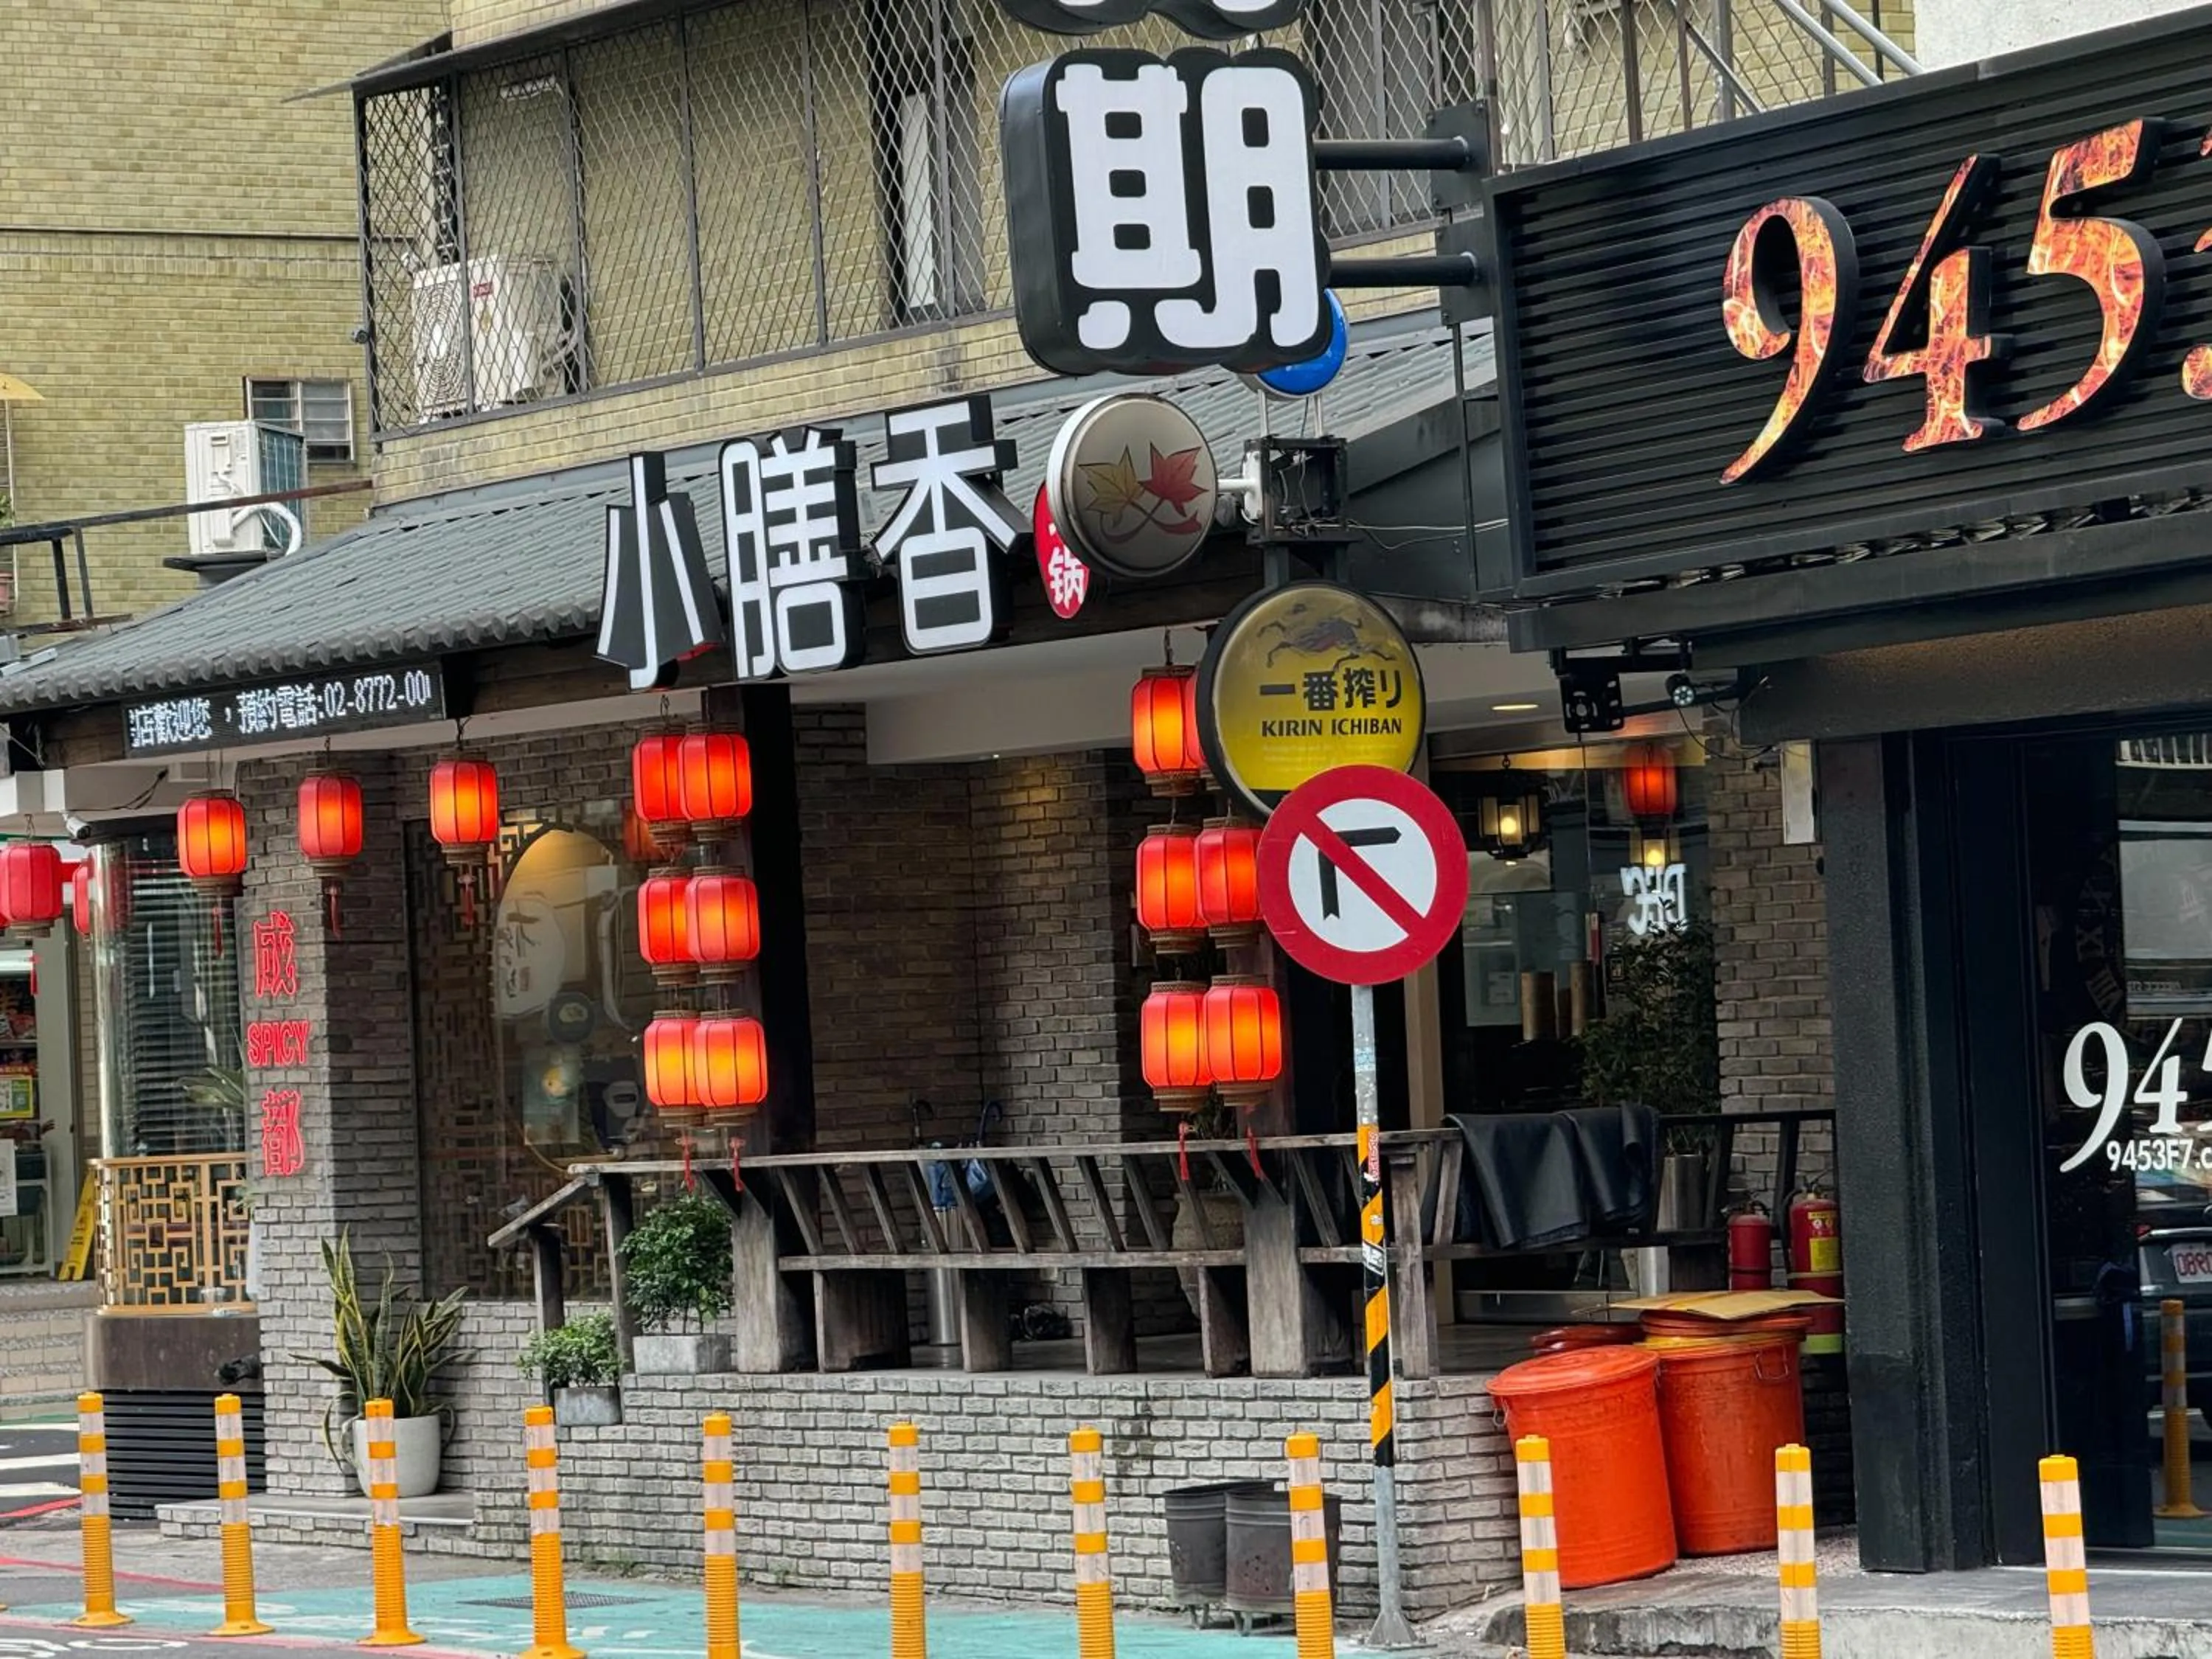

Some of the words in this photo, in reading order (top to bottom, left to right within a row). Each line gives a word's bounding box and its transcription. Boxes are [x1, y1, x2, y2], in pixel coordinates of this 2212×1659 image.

[1719, 118, 2212, 484] 945
[597, 400, 1017, 689] 小膳香
[1259, 667, 1402, 711] 一番搾り
[1262, 719, 1324, 737] KIRIN
[1331, 717, 1402, 735] ICHIBAN
[247, 1020, 310, 1067] SPICY
[2059, 1017, 2212, 1173] 94
[2107, 1138, 2212, 1172] 9453F7.c
